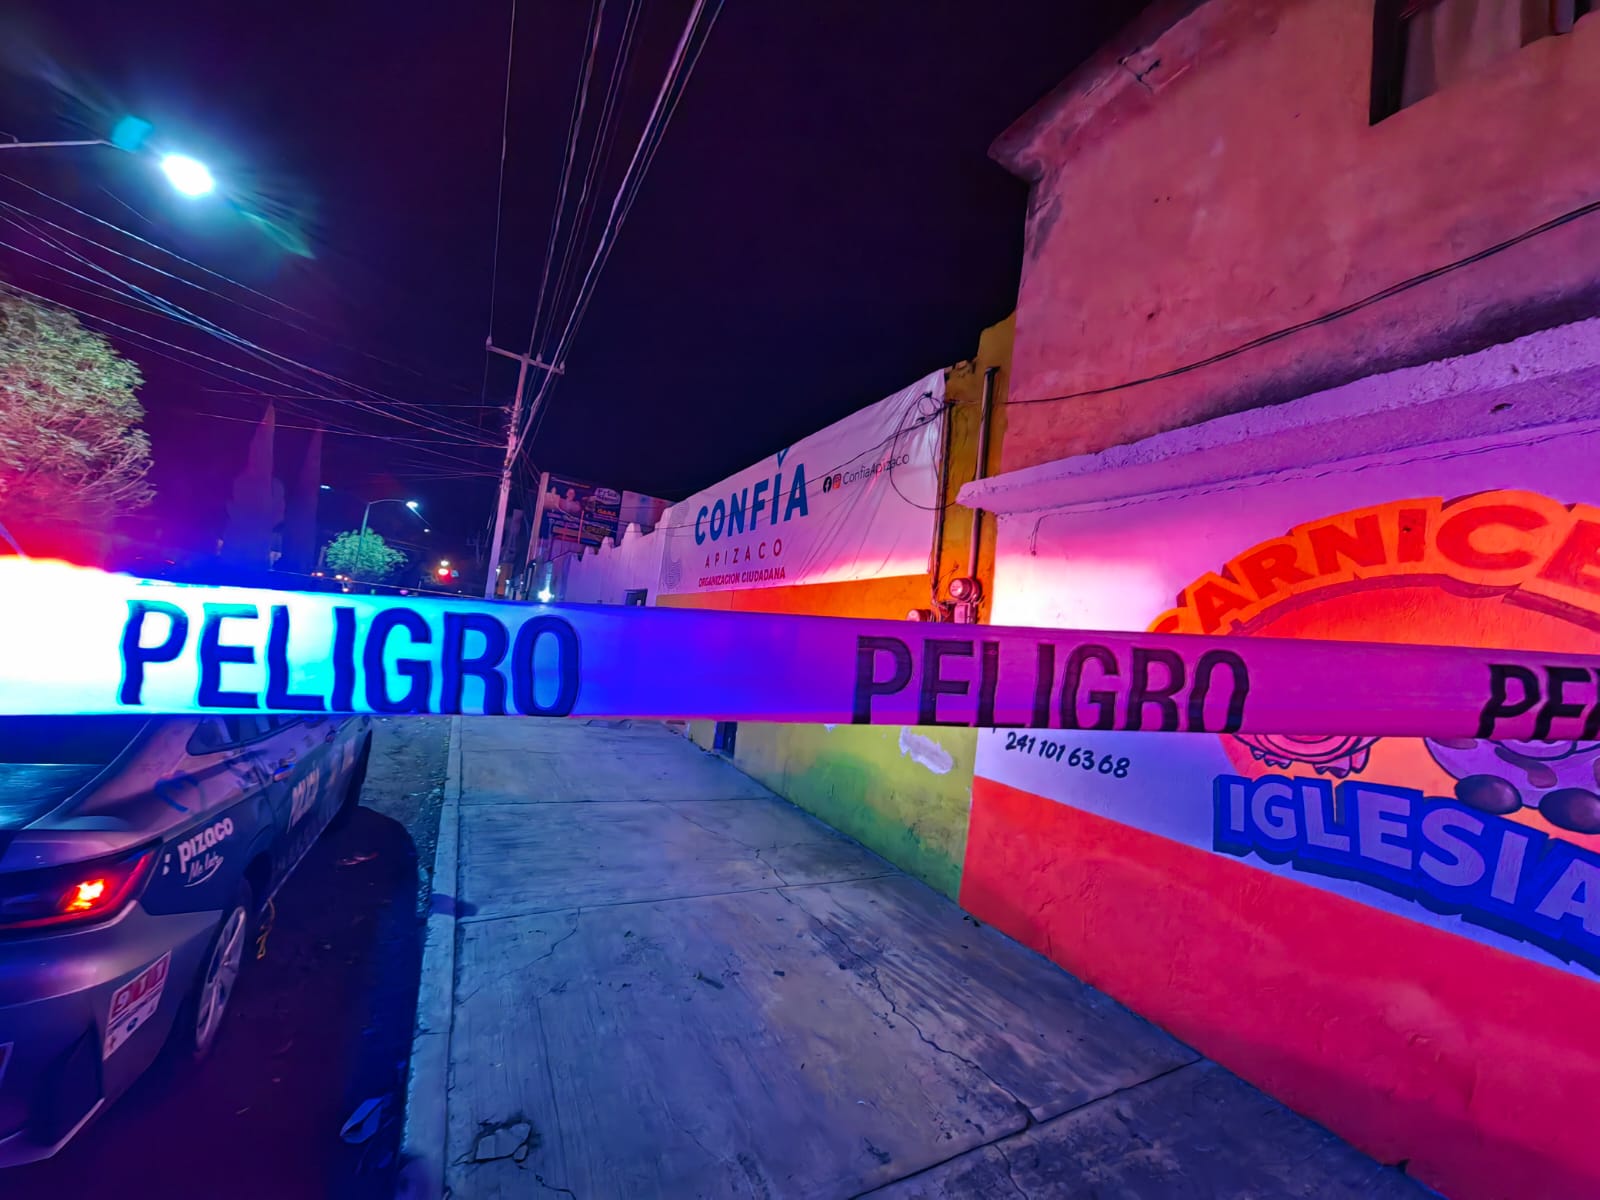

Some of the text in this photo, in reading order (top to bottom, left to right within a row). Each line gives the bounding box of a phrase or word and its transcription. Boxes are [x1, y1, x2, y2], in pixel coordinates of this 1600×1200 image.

[705, 538, 783, 568] APIZACO
[742, 566, 786, 583] CIUDADANA
[119, 600, 582, 716] PELIGRO
[851, 635, 1250, 734] PELIGRO
[1005, 731, 1036, 754] 241
[1039, 739, 1066, 762] 101
